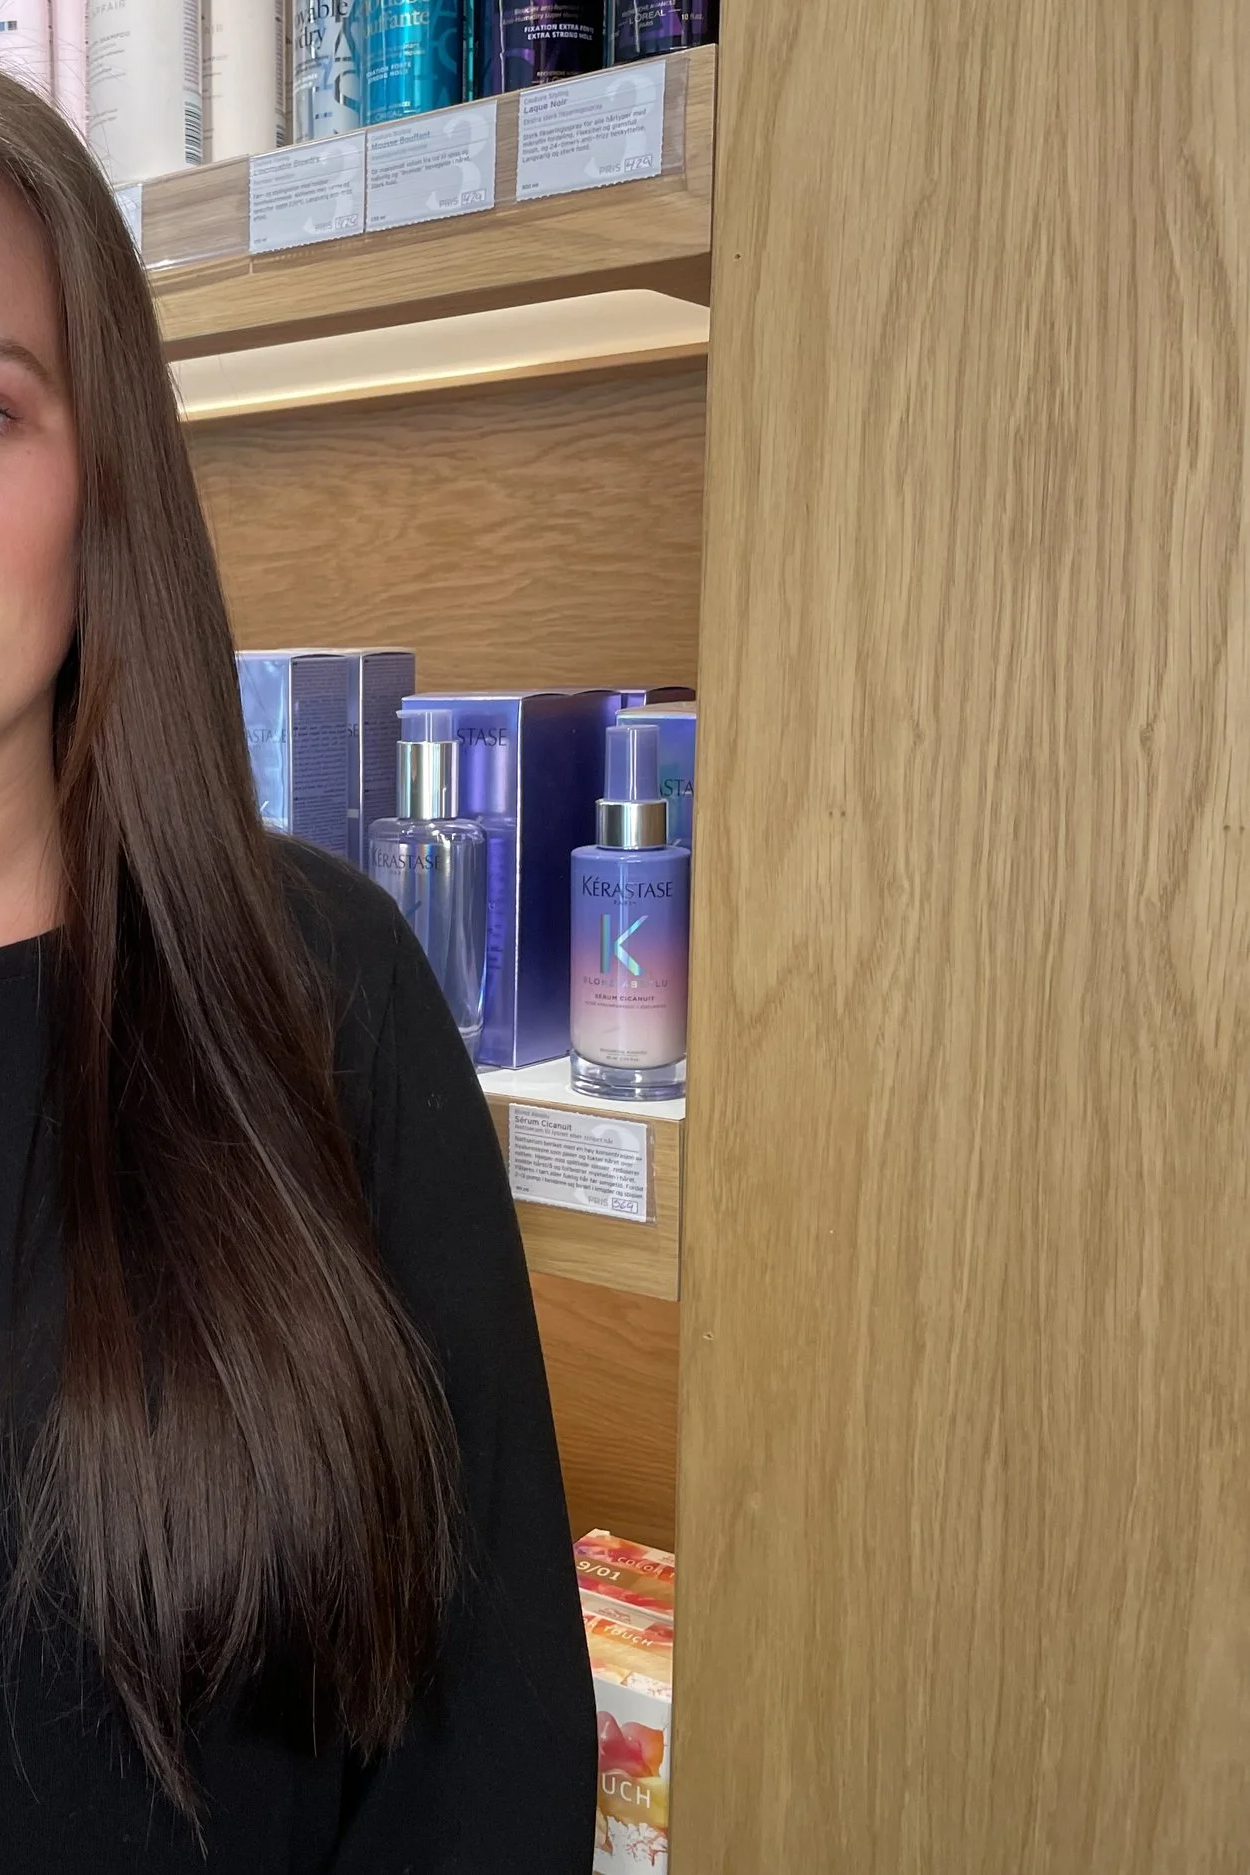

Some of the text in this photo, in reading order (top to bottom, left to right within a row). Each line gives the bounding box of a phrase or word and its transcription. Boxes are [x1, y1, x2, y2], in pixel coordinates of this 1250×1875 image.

[524, 23, 558, 33] FIXATION
[558, 23, 579, 31] EXTRA
[527, 31, 551, 41] EXTRA
[552, 31, 578, 39] STRONG
[523, 98, 568, 114] Laque Noir
[632, 108, 647, 117] med
[371, 141, 398, 151] Mousse
[599, 163, 621, 176] PRIS
[455, 727, 508, 747] STASE
[582, 875, 674, 899] KÉRASTASE
[619, 995, 656, 1003] CICANUIT
[514, 1115, 573, 1131] Sérum Cicanuit
[588, 1195, 609, 1207] PRIS
[576, 1560, 622, 1581] 9/01
[602, 1772, 651, 1809] UCH
